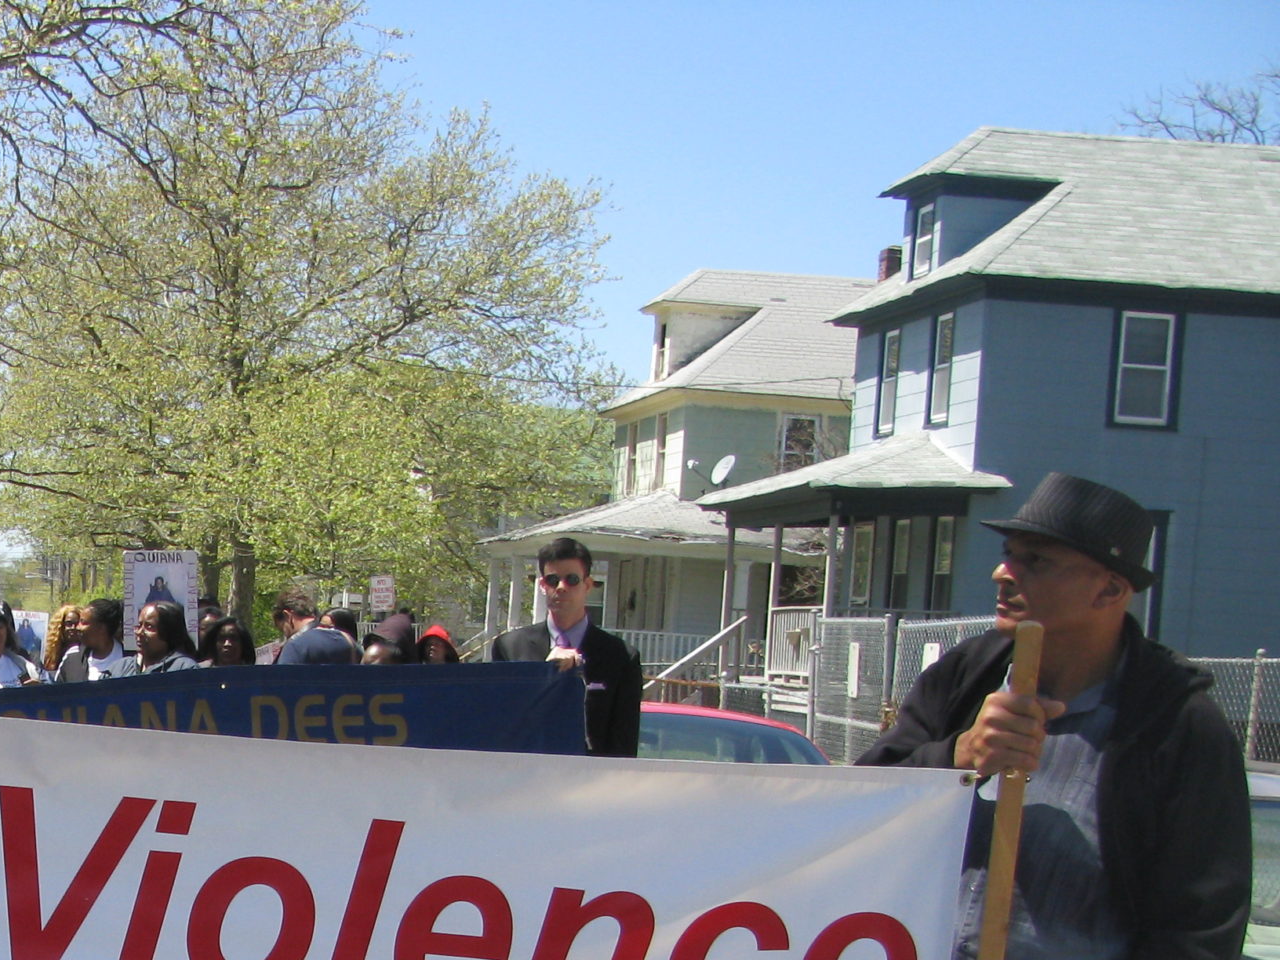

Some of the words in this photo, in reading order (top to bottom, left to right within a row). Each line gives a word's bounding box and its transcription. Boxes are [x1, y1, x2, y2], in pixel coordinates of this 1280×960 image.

[134, 552, 184, 563] QUIANA
[124, 619, 134, 637] NO
[250, 694, 409, 746] DEES
